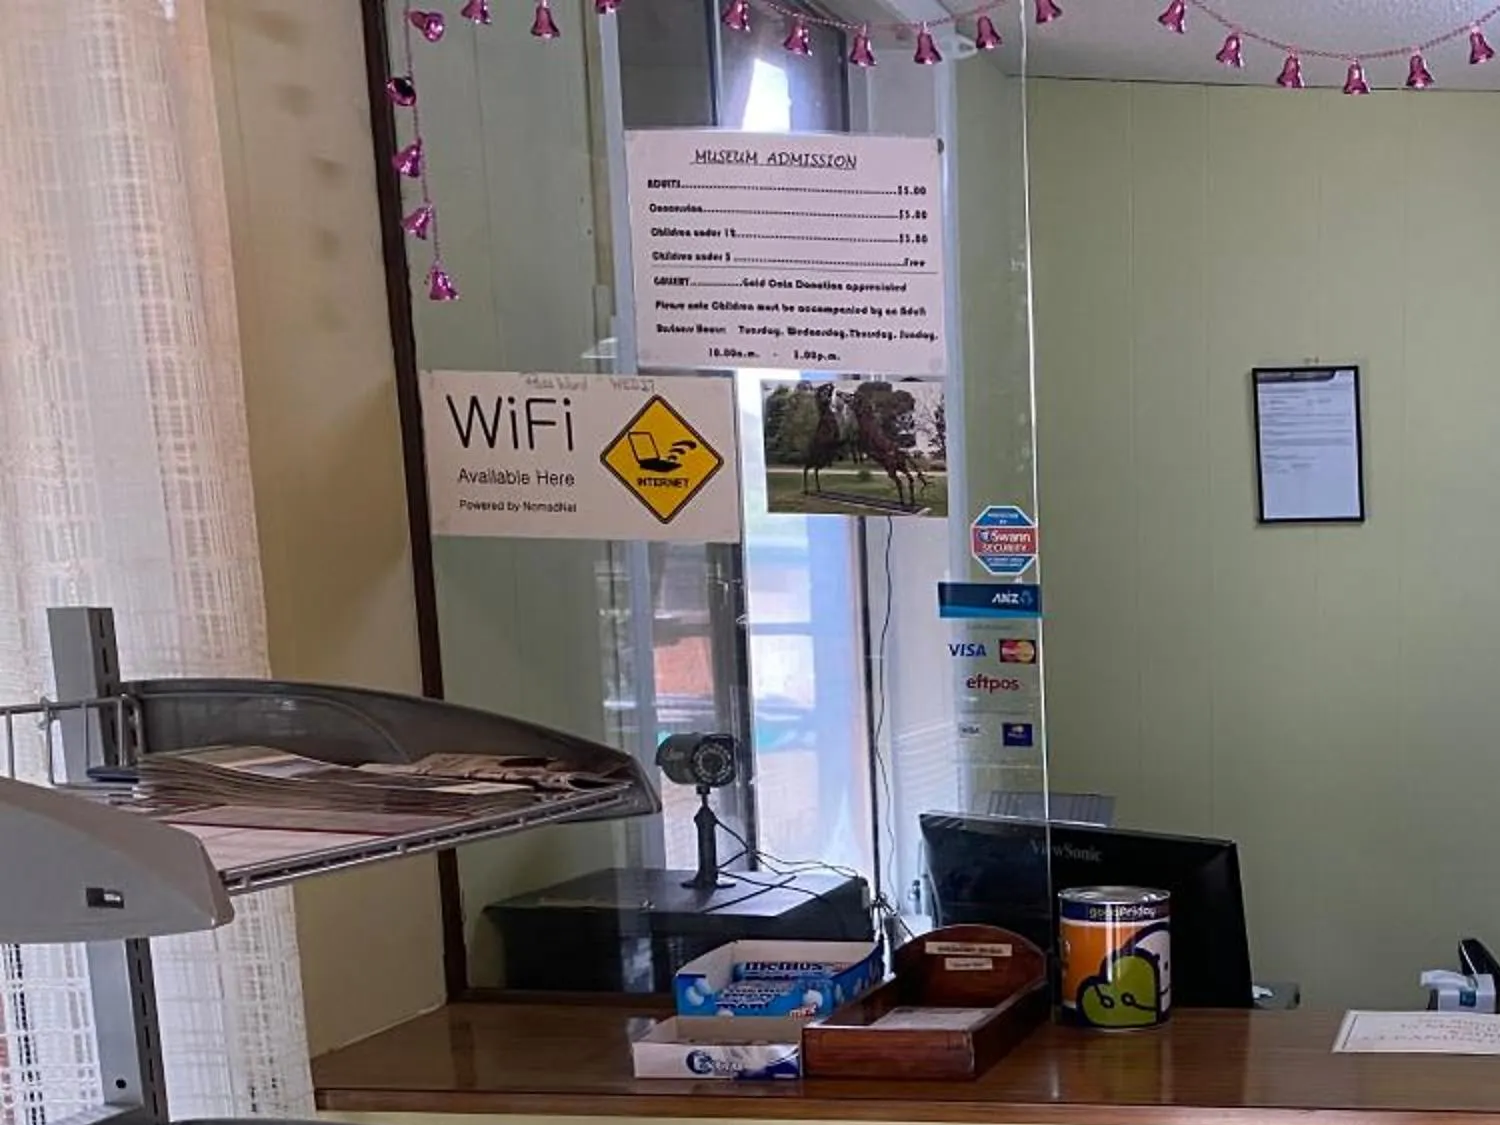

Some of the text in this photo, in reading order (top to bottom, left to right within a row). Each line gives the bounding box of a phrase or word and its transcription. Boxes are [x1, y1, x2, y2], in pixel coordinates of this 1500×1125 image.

[695, 149, 857, 170] MUSEUM ADMISSION
[650, 228, 691, 237] Children
[693, 229, 721, 237] under
[652, 251, 693, 261] Children
[695, 251, 723, 261] under
[795, 280, 843, 290] Donation
[655, 301, 685, 310] Please
[711, 302, 755, 311] Children
[781, 303, 795, 313] be
[797, 305, 868, 316] accompanied
[869, 306, 883, 317] by
[445, 394, 573, 451] WiFi
[457, 467, 575, 487] Available Here
[636, 477, 690, 488] INTERNET
[459, 499, 504, 511] Powered
[507, 501, 520, 513] by
[990, 529, 1032, 543] Swann
[991, 592, 1020, 605] ANZ
[948, 642, 988, 657] VISA
[966, 673, 1020, 693] eftpos
